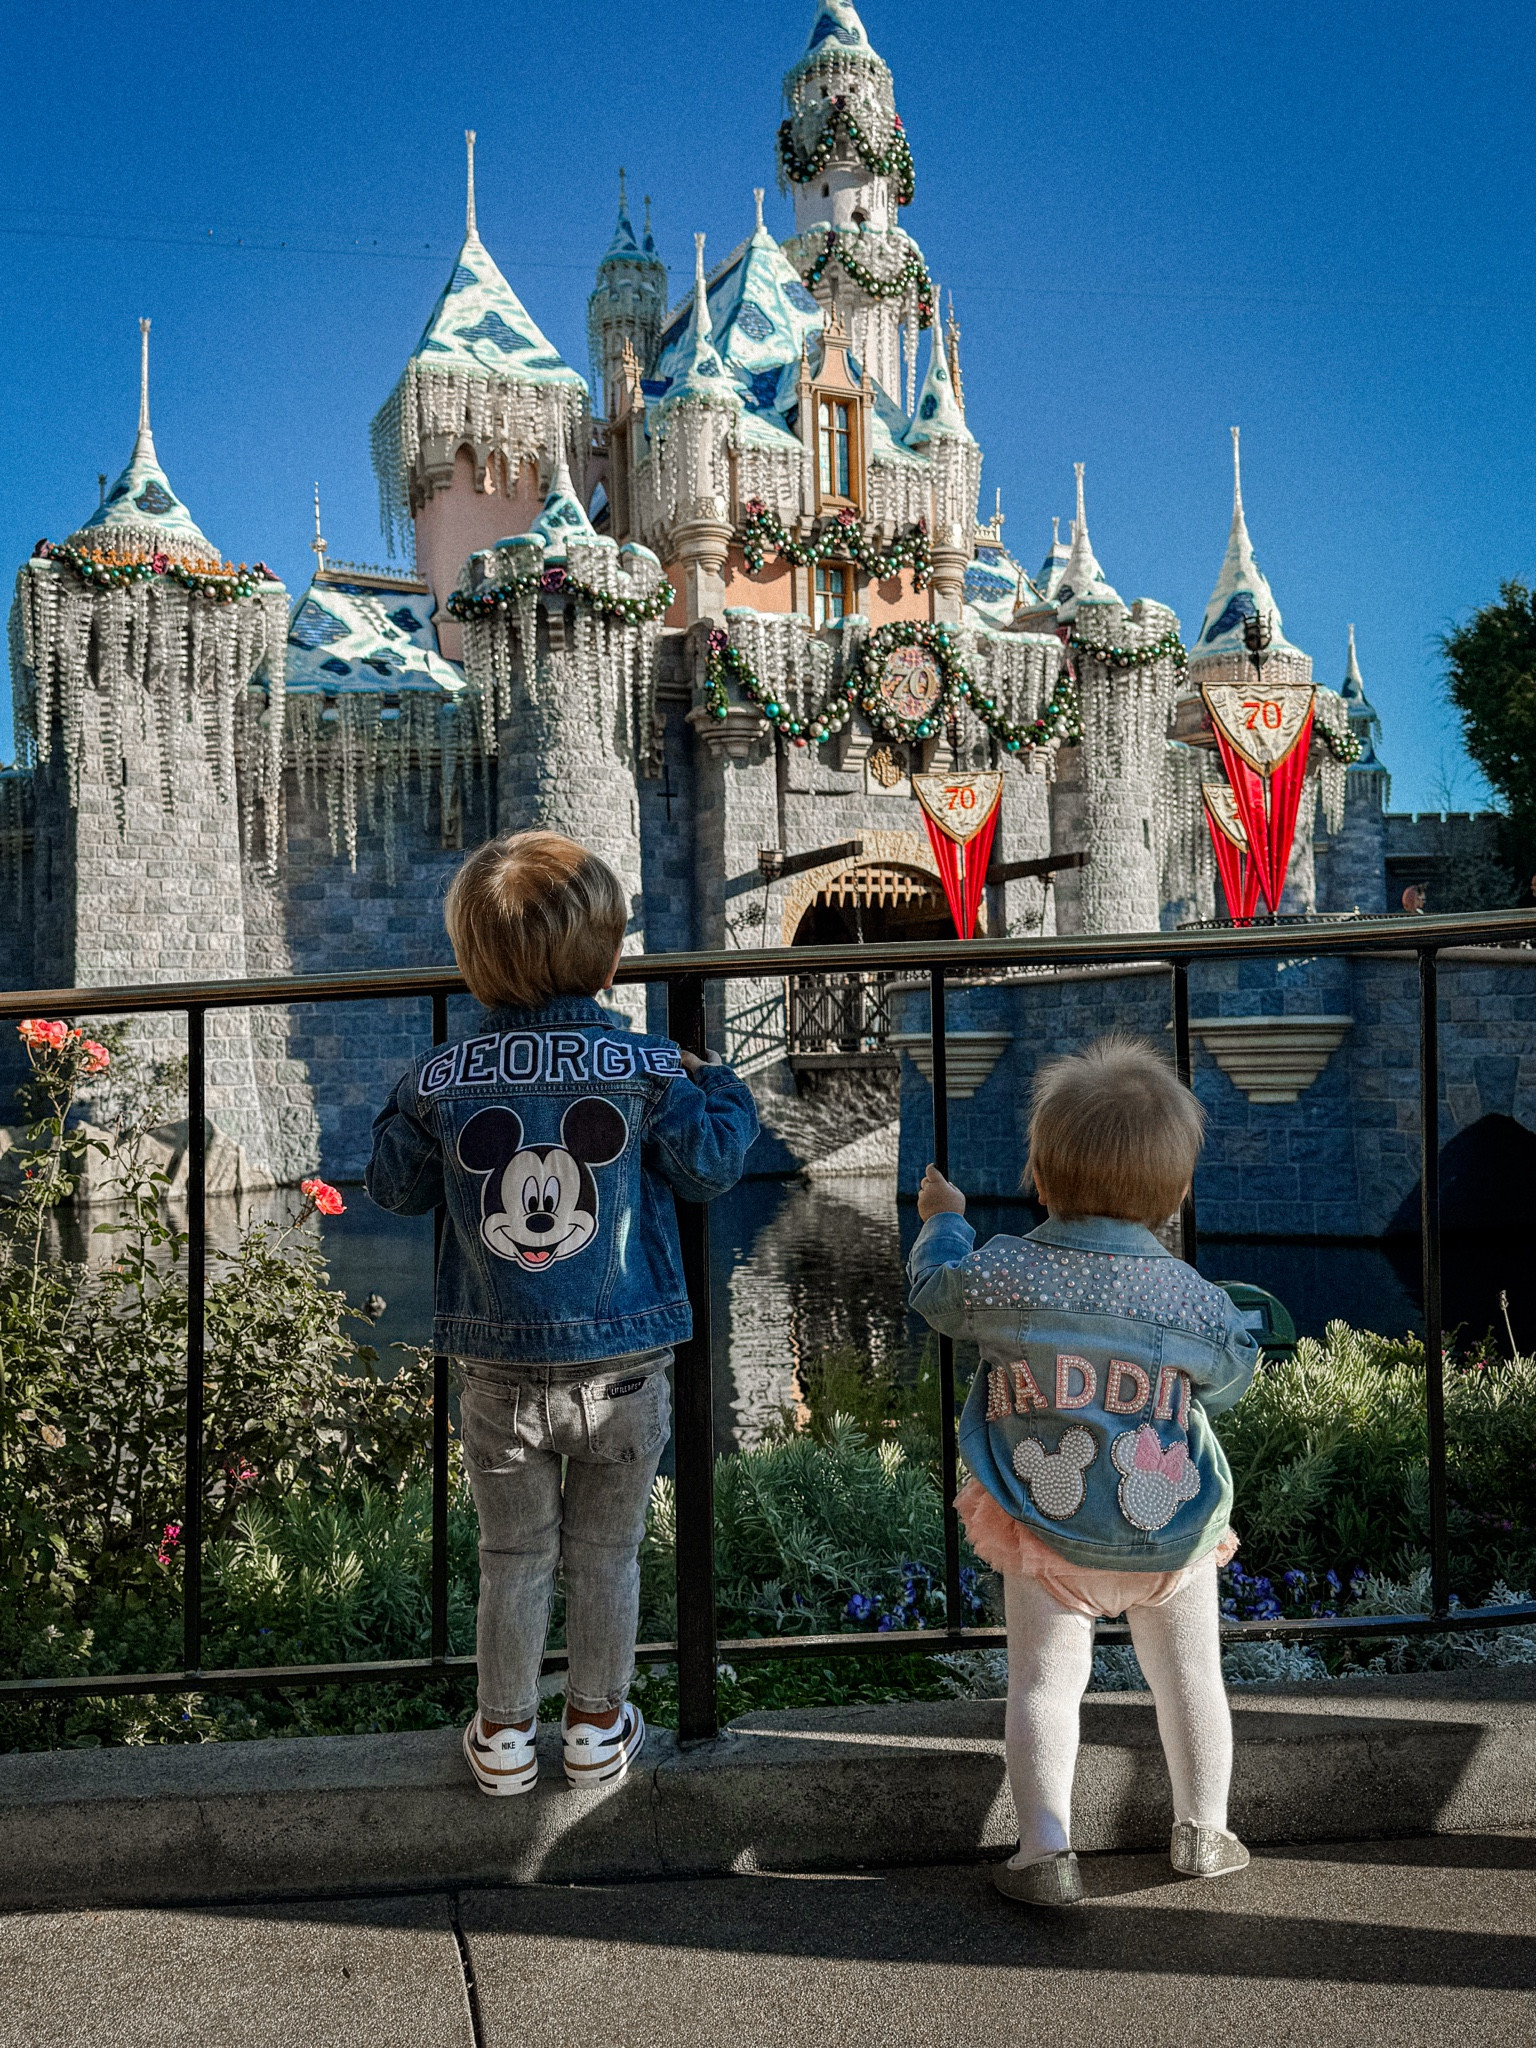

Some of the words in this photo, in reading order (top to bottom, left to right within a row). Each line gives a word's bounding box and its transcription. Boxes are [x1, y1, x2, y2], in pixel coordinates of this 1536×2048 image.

[893, 667, 936, 699] 70
[1242, 701, 1282, 729] 70
[944, 786, 976, 810] 70
[418, 1031, 687, 1096] GEORGE
[501, 1741, 516, 1750] NIKE
[575, 1737, 590, 1746] NIKE
